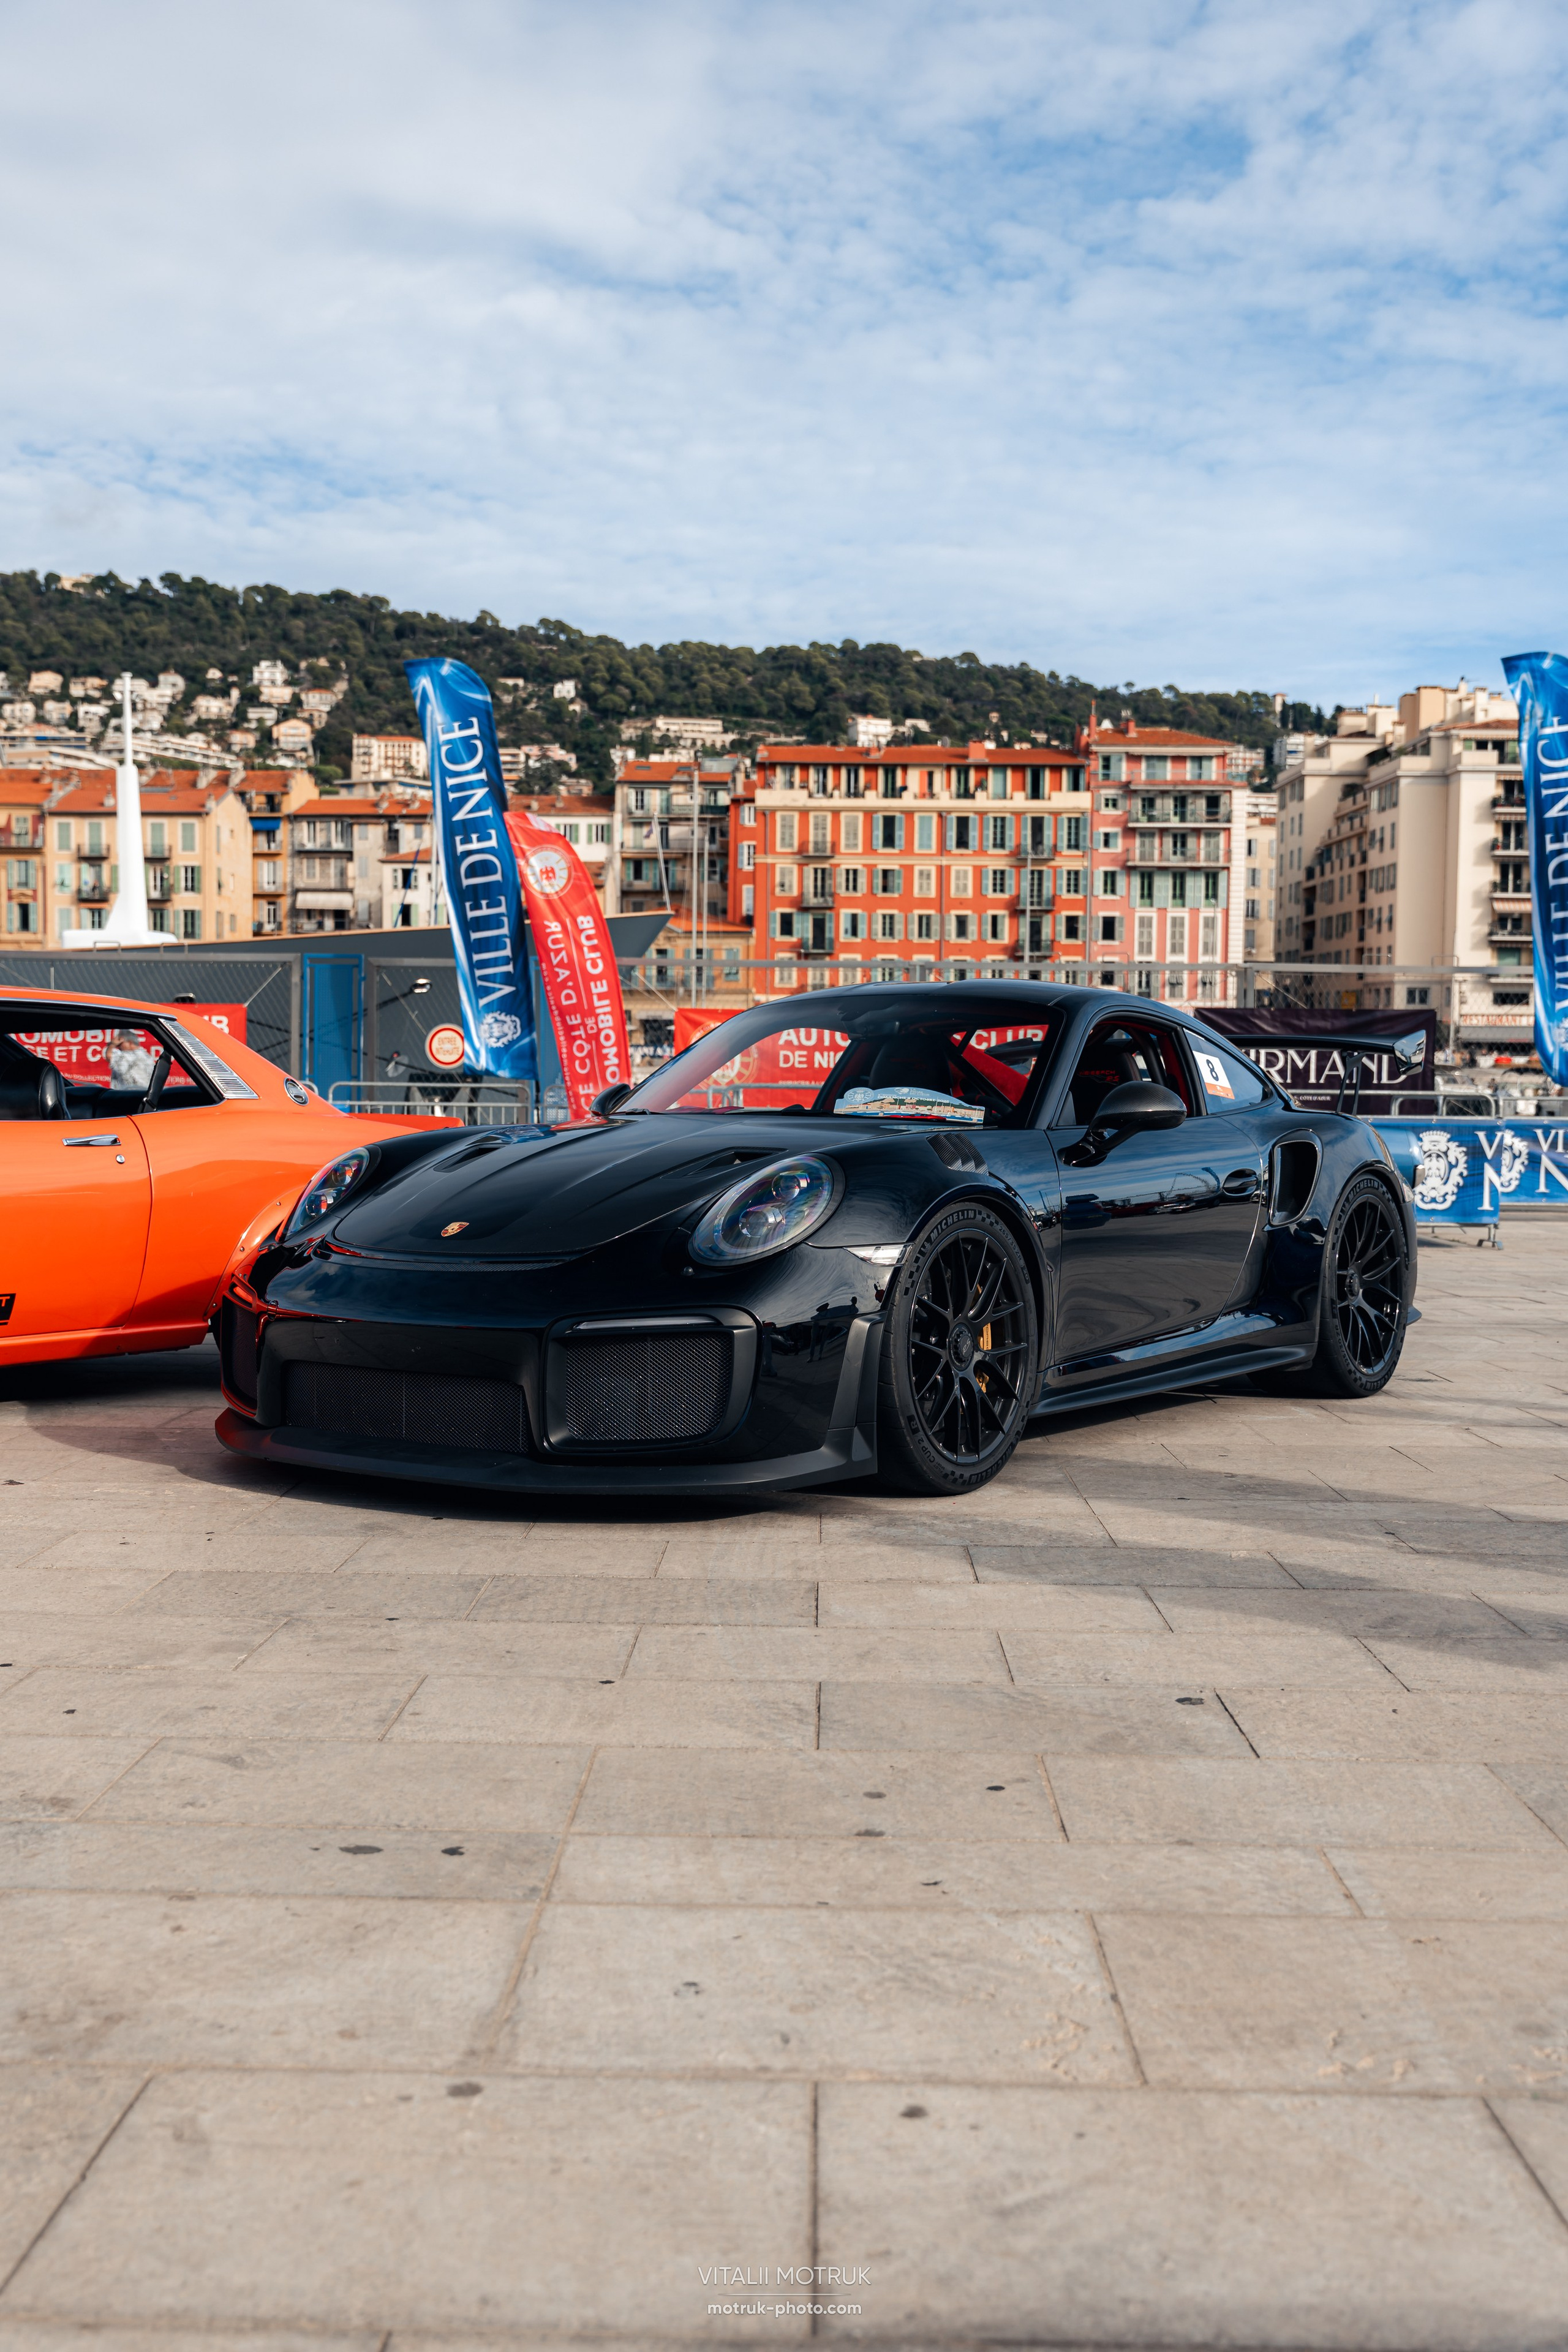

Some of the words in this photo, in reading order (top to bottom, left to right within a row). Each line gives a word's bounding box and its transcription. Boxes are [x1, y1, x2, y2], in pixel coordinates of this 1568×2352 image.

[438, 716, 493, 822] NICE
[454, 829, 502, 890] DE
[465, 895, 516, 1008] VILLE
[1462, 1015, 1523, 1025] RESTAURANT
[54, 1046, 82, 1062] ET
[779, 1050, 808, 1068] DE
[813, 1051, 845, 1068] NI
[1205, 1059, 1219, 1082] 8
[1242, 1049, 1408, 1084] RMAND
[1348, 1180, 1379, 1201] MICHELIN
[930, 1210, 974, 1242] MICHELIN
[910, 1420, 918, 1429] R
[921, 1446, 935, 1463] CUP
